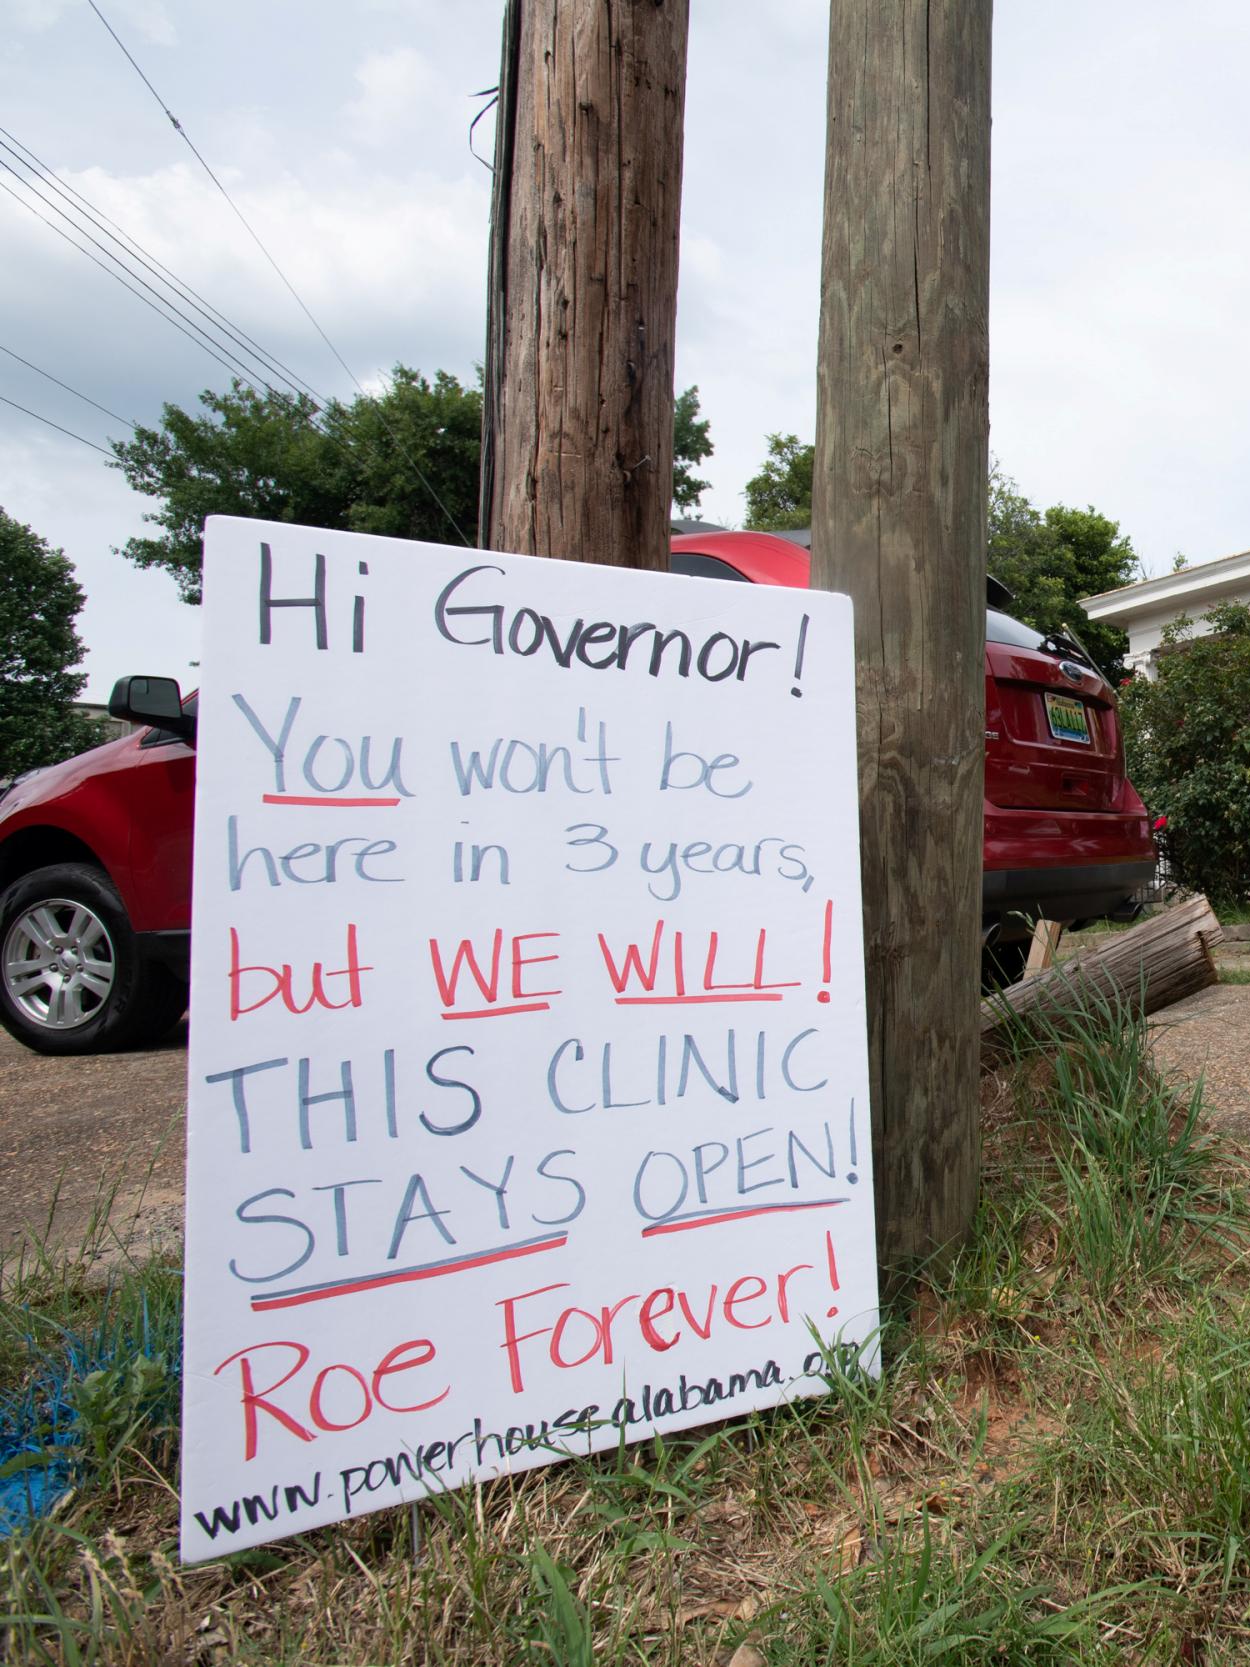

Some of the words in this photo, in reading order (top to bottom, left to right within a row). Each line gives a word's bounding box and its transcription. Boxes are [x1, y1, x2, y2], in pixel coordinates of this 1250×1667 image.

[259, 542, 369, 653] Hi
[434, 565, 810, 698] Governor!
[232, 694, 416, 796] You
[451, 708, 619, 796] won't
[660, 721, 749, 798] be
[229, 816, 403, 891] here
[454, 820, 510, 884] in
[566, 824, 618, 872] 3
[641, 839, 814, 901] years,
[228, 924, 373, 1021] but
[430, 929, 561, 1007] WE
[598, 899, 834, 1003] WILL!
[205, 1046, 481, 1153] THIS
[548, 1029, 827, 1113] CLINIC
[228, 1149, 587, 1284] STAYS
[633, 1096, 859, 1221] OPEN!
[214, 1340, 451, 1461] Roe
[495, 1230, 841, 1394] Forever!
